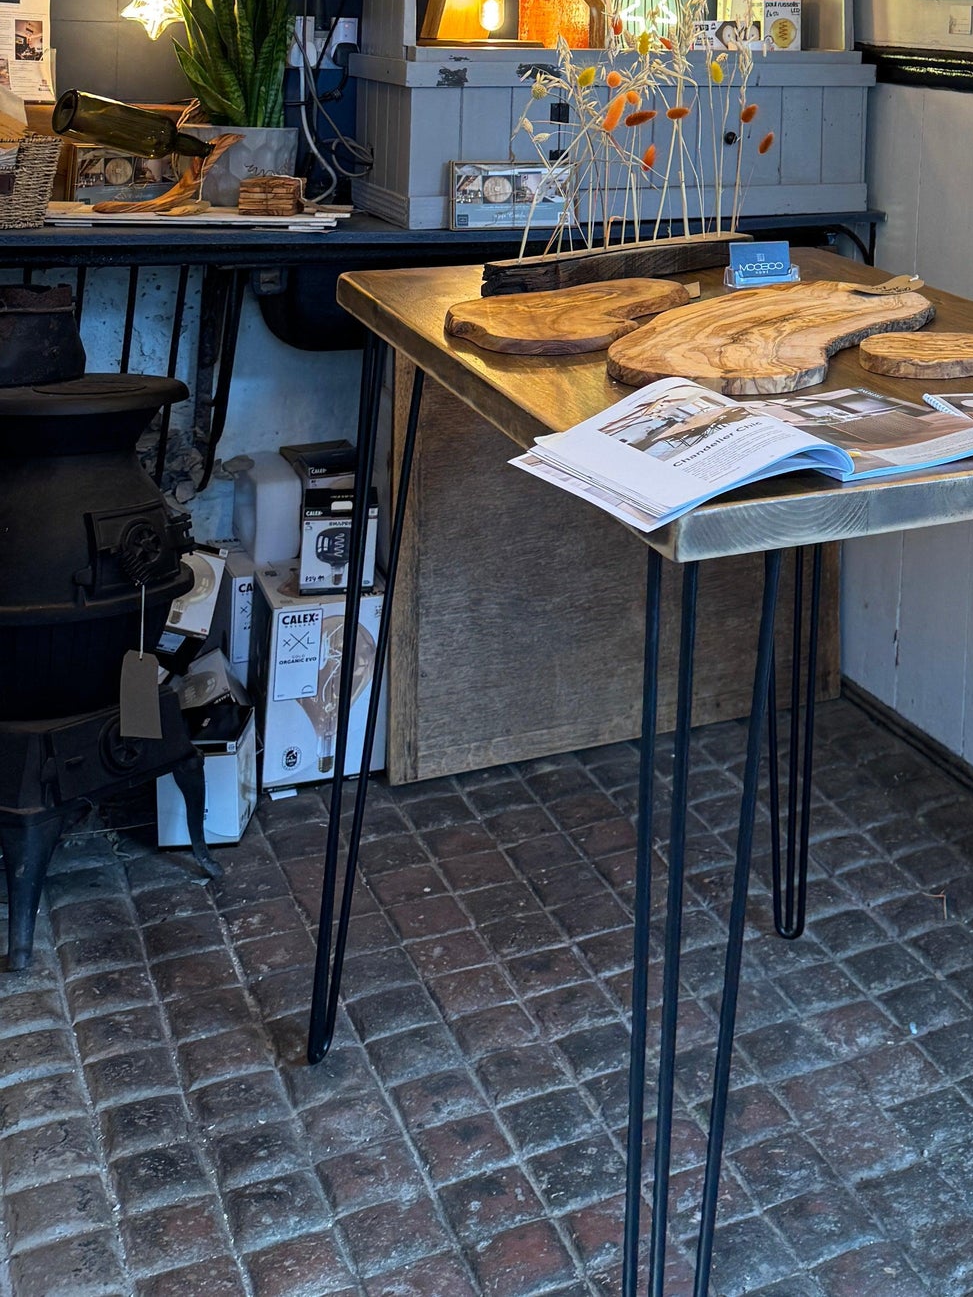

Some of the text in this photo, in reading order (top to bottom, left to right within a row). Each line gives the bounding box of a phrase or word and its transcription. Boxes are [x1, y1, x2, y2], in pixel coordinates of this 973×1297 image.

[673, 432, 734, 468] Chandelier
[735, 421, 764, 433] Chic
[282, 613, 319, 625] CALEX
[283, 631, 316, 652] XXL
